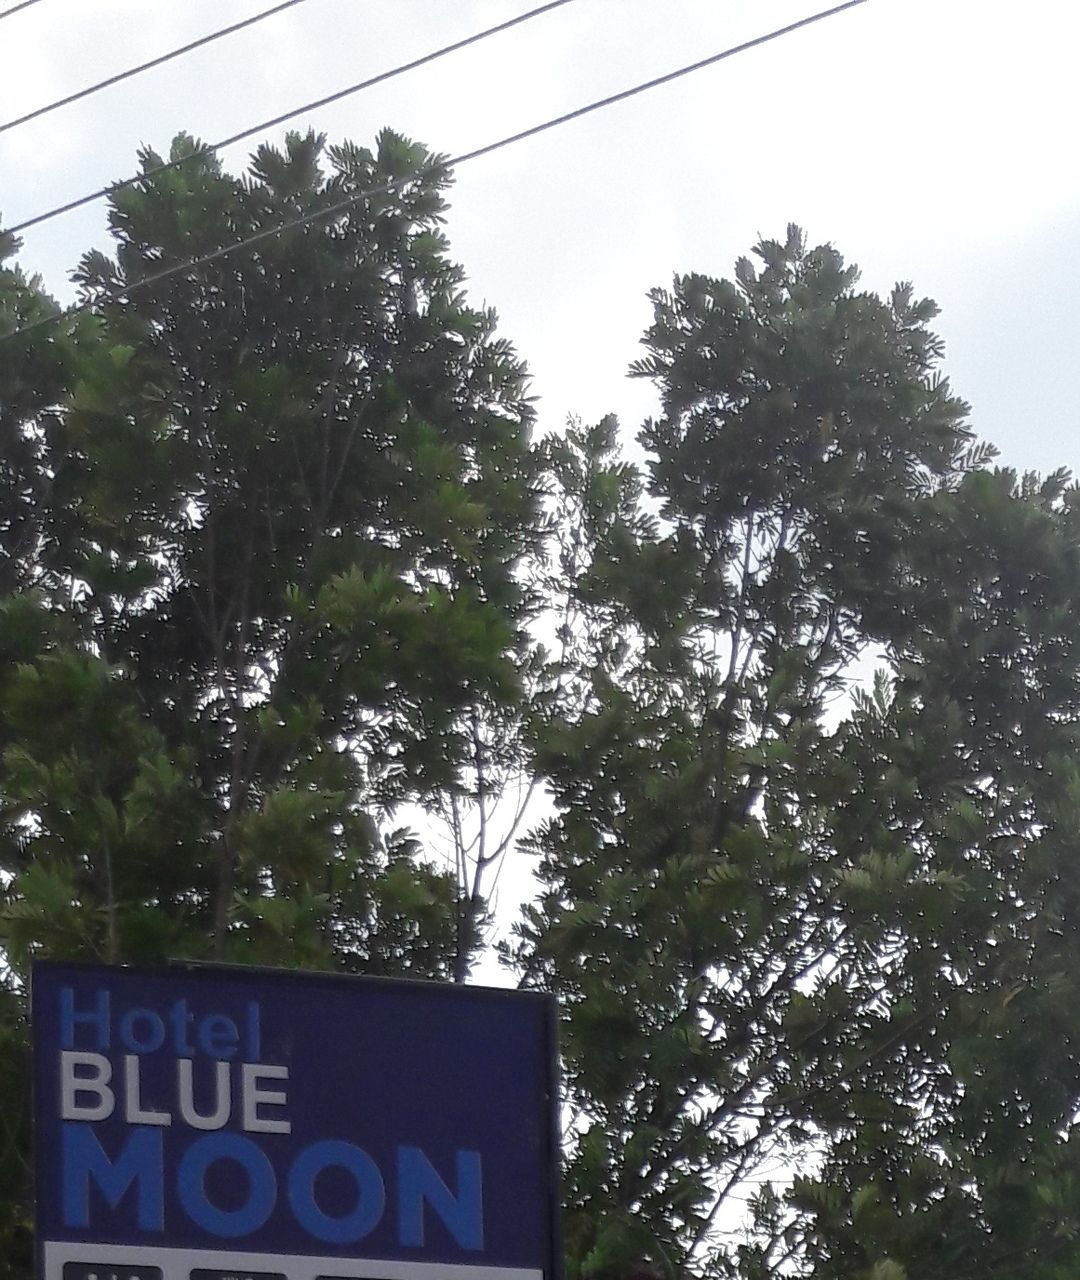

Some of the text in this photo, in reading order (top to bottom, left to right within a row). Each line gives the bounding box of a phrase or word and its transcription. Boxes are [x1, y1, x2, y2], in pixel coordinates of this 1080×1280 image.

[61, 987, 261, 1061] Hotel
[61, 1050, 292, 1134] BLUE
[61, 1122, 484, 1251] MOON
